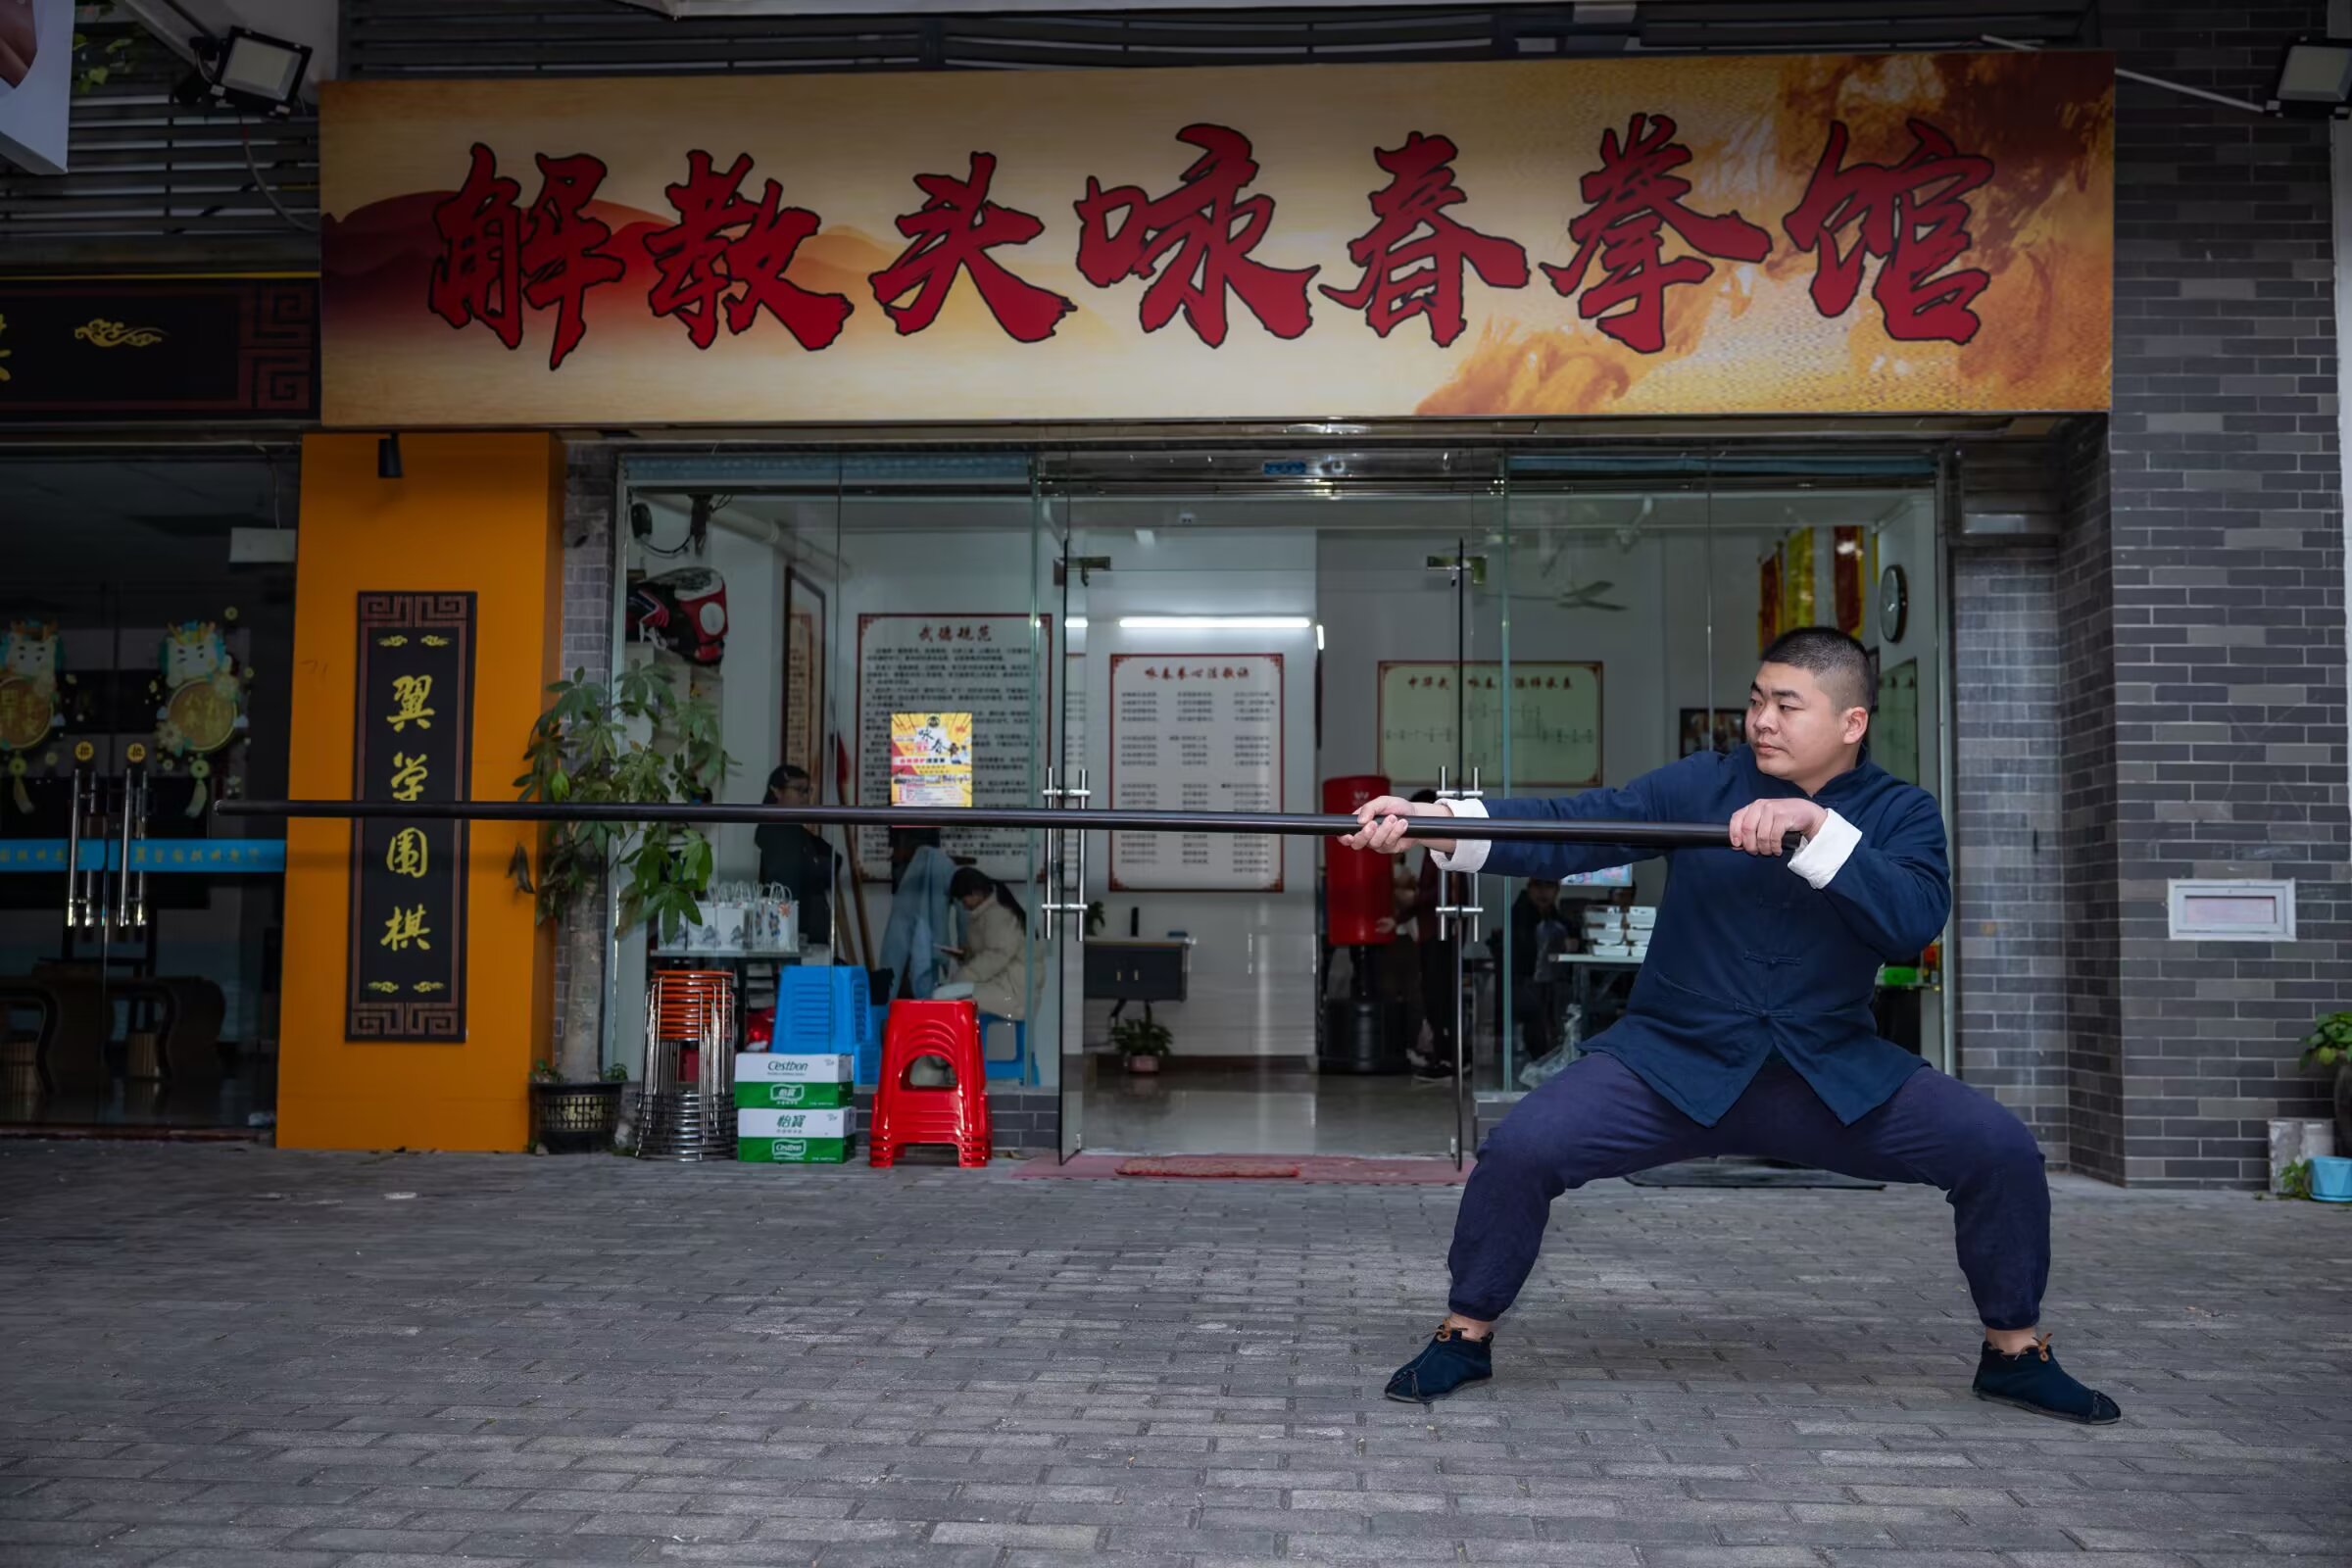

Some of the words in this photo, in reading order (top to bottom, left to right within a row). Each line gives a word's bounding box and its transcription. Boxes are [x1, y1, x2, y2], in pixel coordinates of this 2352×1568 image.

[428, 113, 1994, 370] 解教头咏春拳馆
[379, 673, 436, 952] 翼学围棋
[776, 1114, 807, 1129] 怡寶
